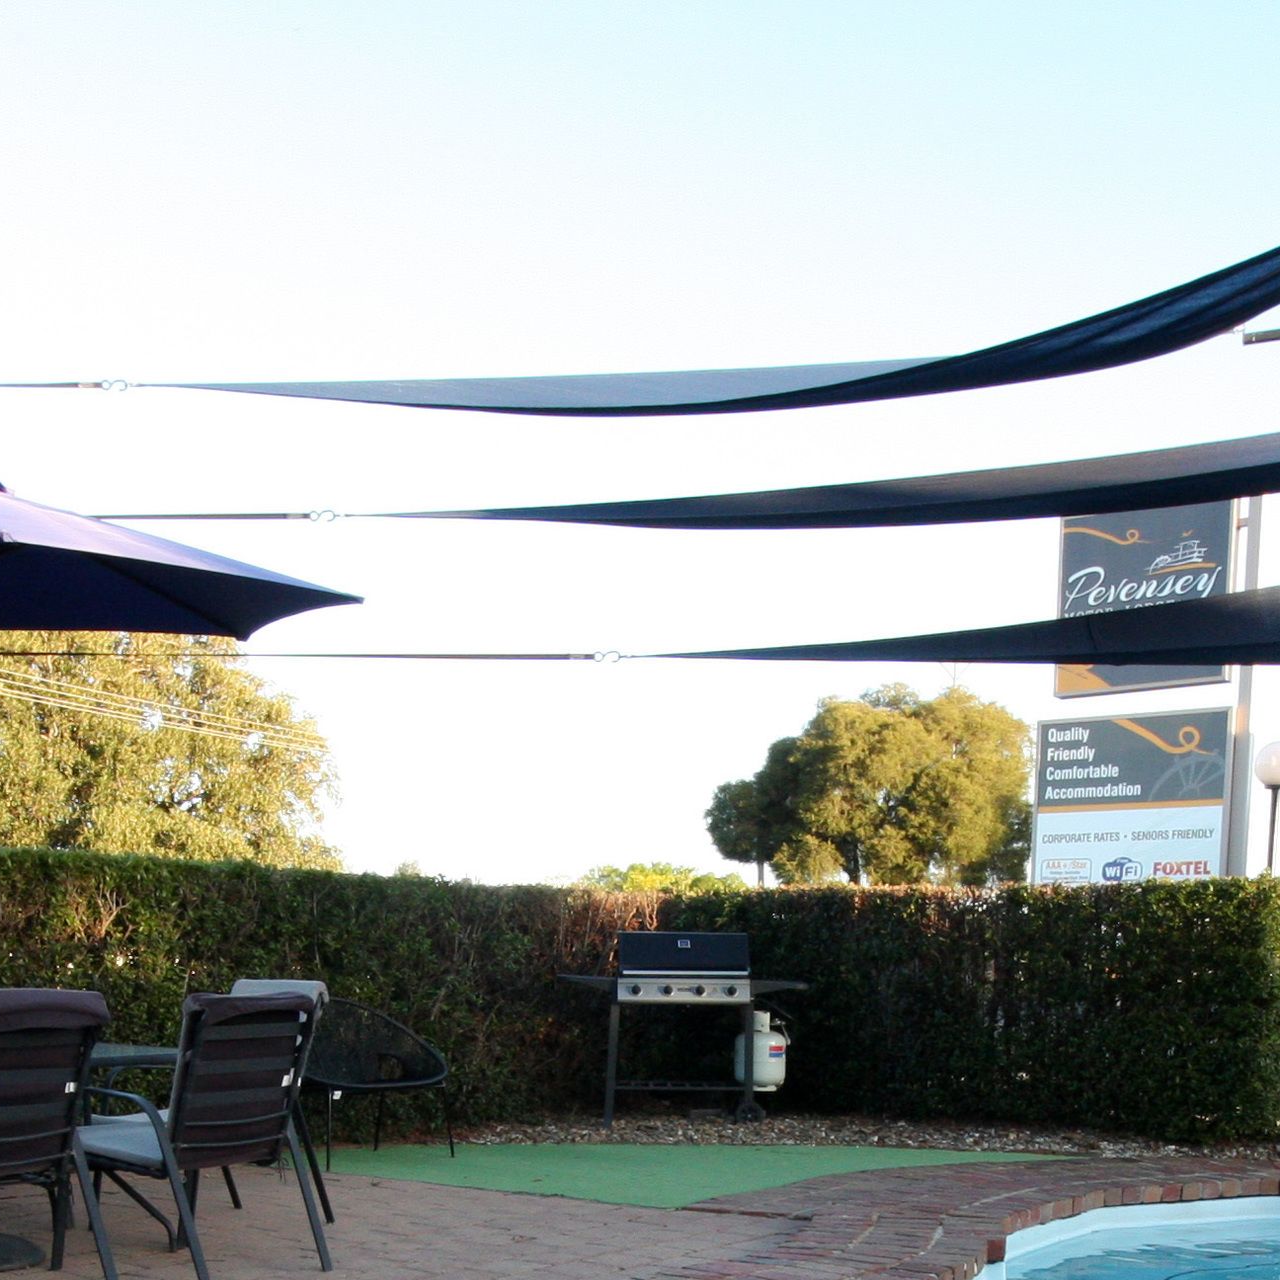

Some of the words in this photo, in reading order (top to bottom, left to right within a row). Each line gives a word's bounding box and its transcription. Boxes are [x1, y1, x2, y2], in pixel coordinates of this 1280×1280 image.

[1065, 566, 1222, 610] Pevensey
[1048, 727, 1090, 743] Quality
[1047, 746, 1095, 762] Friendly
[1046, 764, 1119, 780] Comfortable
[1045, 782, 1141, 800] Accommodation
[1042, 832, 1092, 844] CORPORATE
[1093, 831, 1120, 843] RATES
[1131, 830, 1170, 841] SENIORS
[1171, 828, 1215, 840] FRIENDLY
[1152, 860, 1211, 876] FOXTEL
